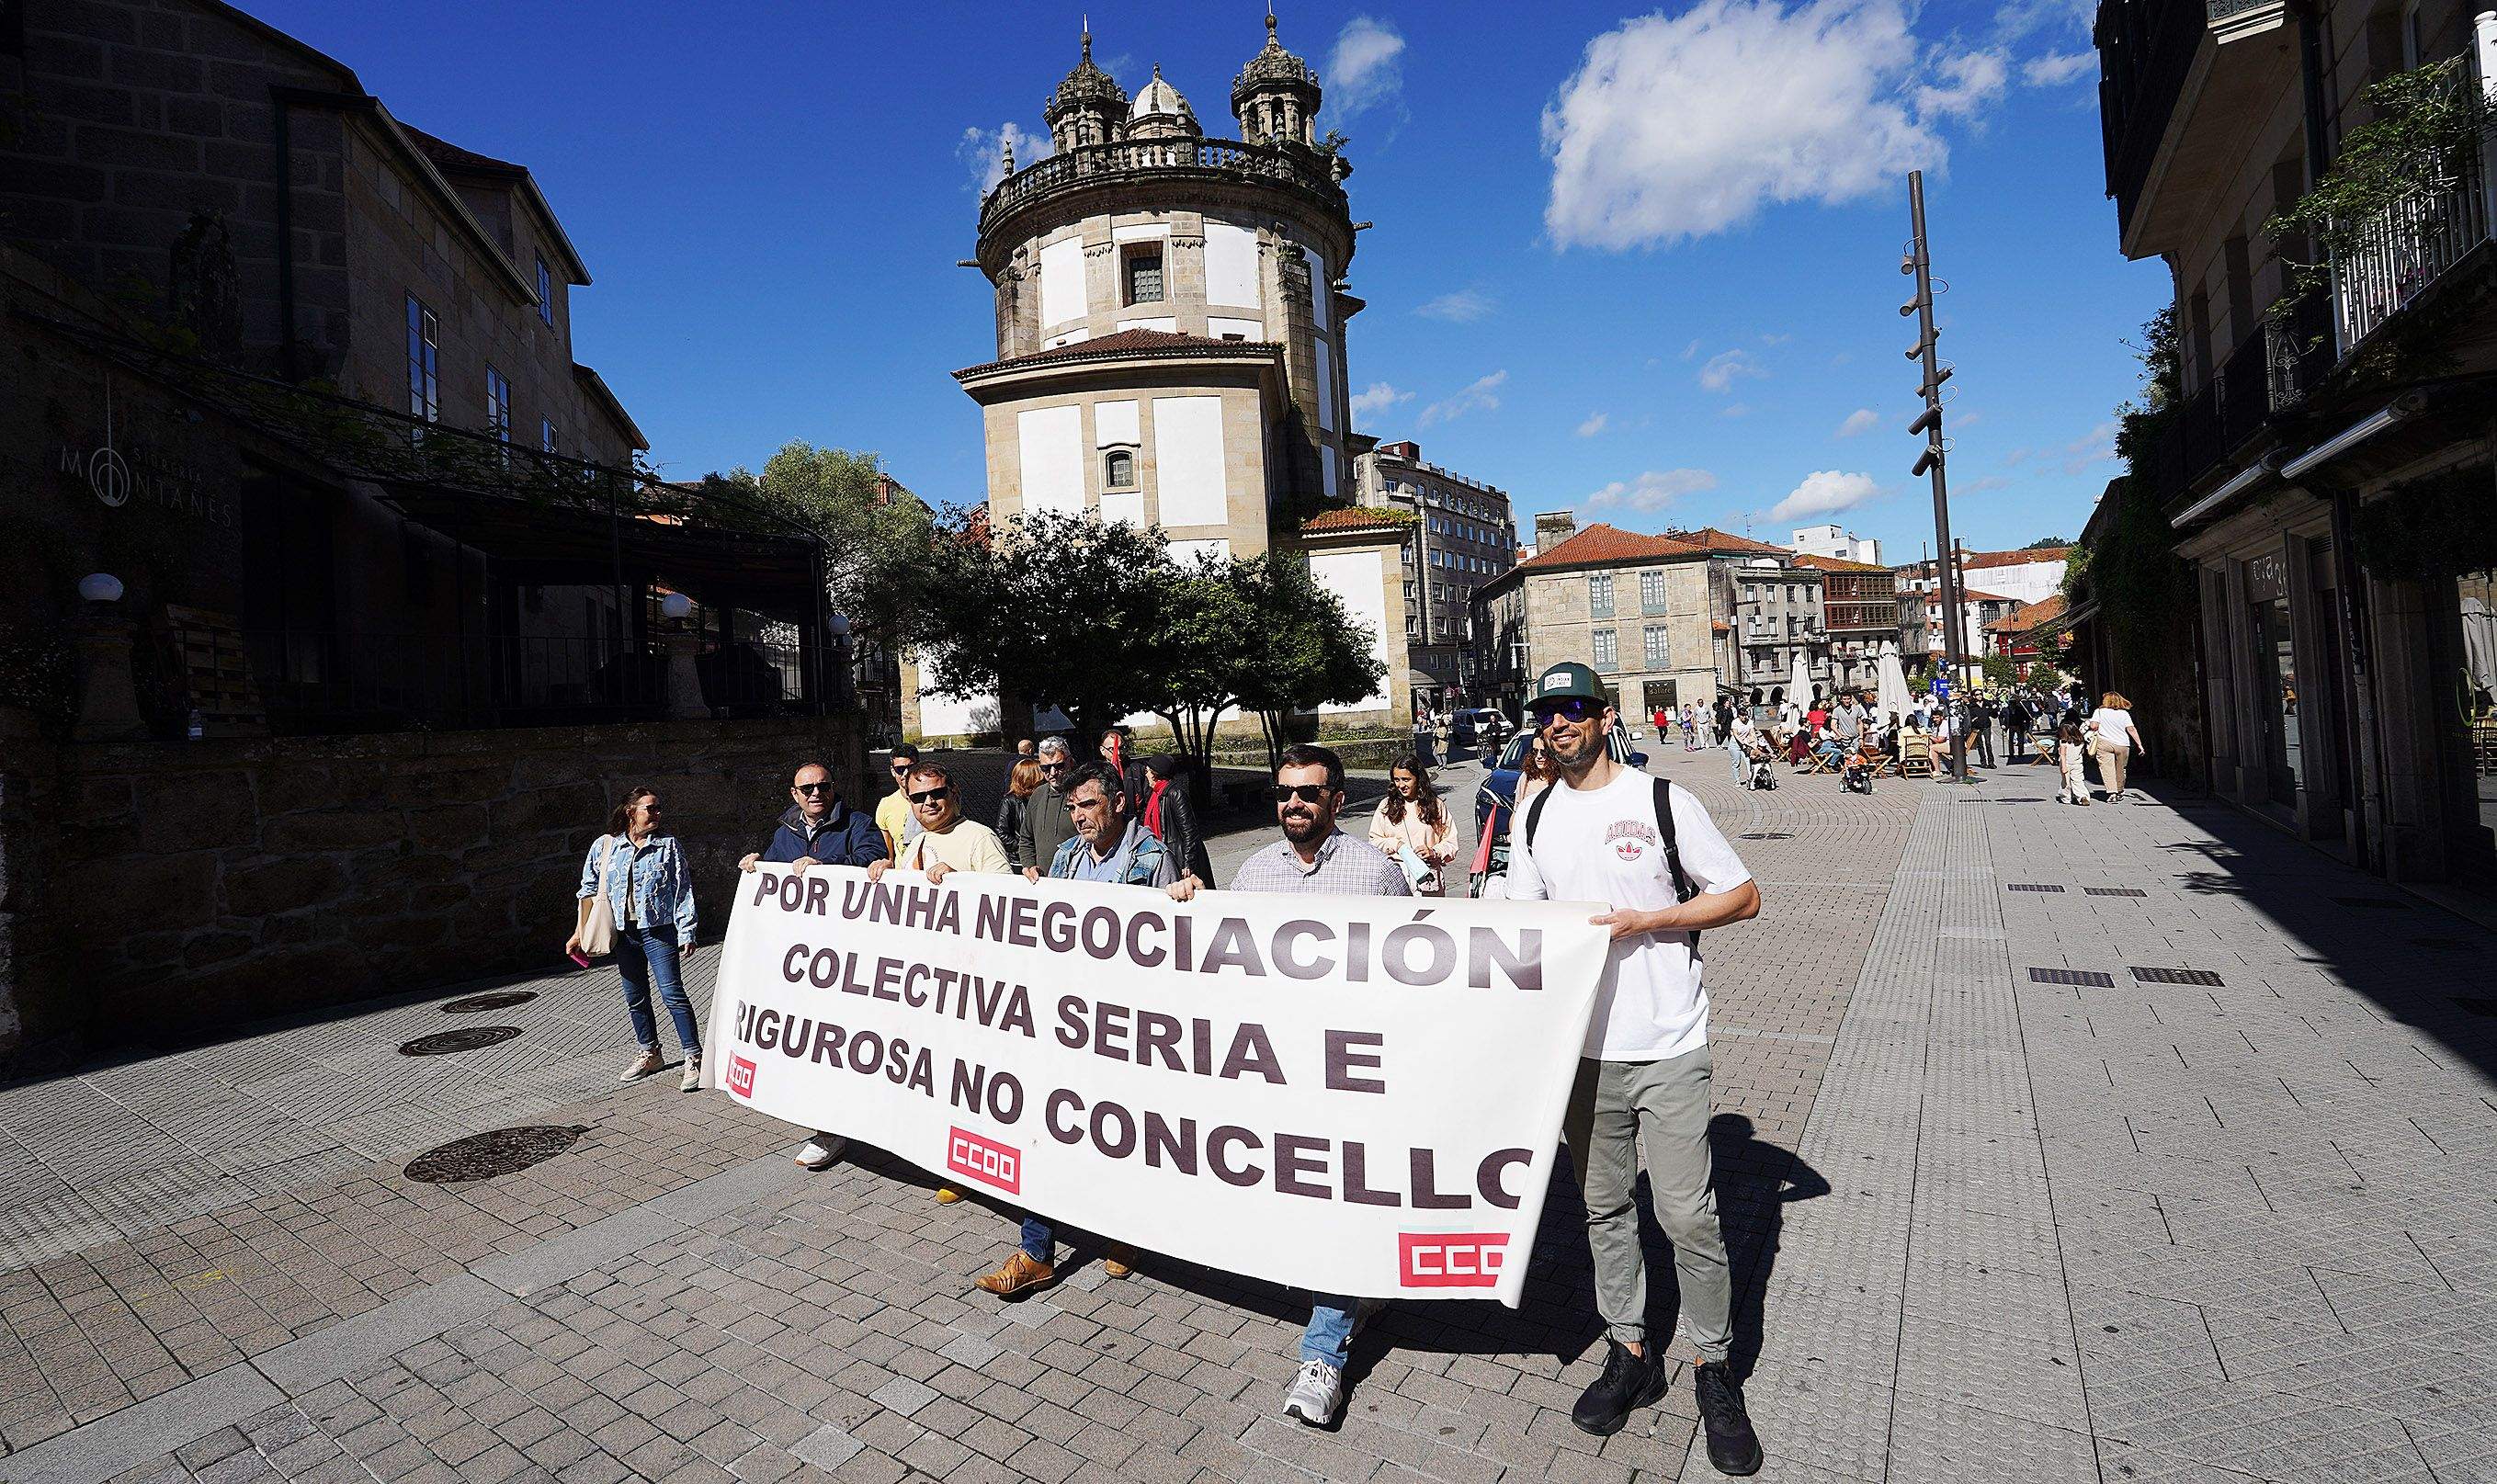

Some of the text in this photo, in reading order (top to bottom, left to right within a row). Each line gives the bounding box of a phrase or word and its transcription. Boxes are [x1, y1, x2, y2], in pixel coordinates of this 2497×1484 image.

[1605, 820, 1656, 847] ADIDAS
[754, 873, 1543, 991] POR UNHA NEGOCIACIÓN
[733, 999, 934, 1098] RIGUROSA
[950, 1058, 1024, 1125] NO
[783, 944, 1385, 1094] COLECTIVA SERIA E
[952, 1138, 1016, 1188] CCOO
